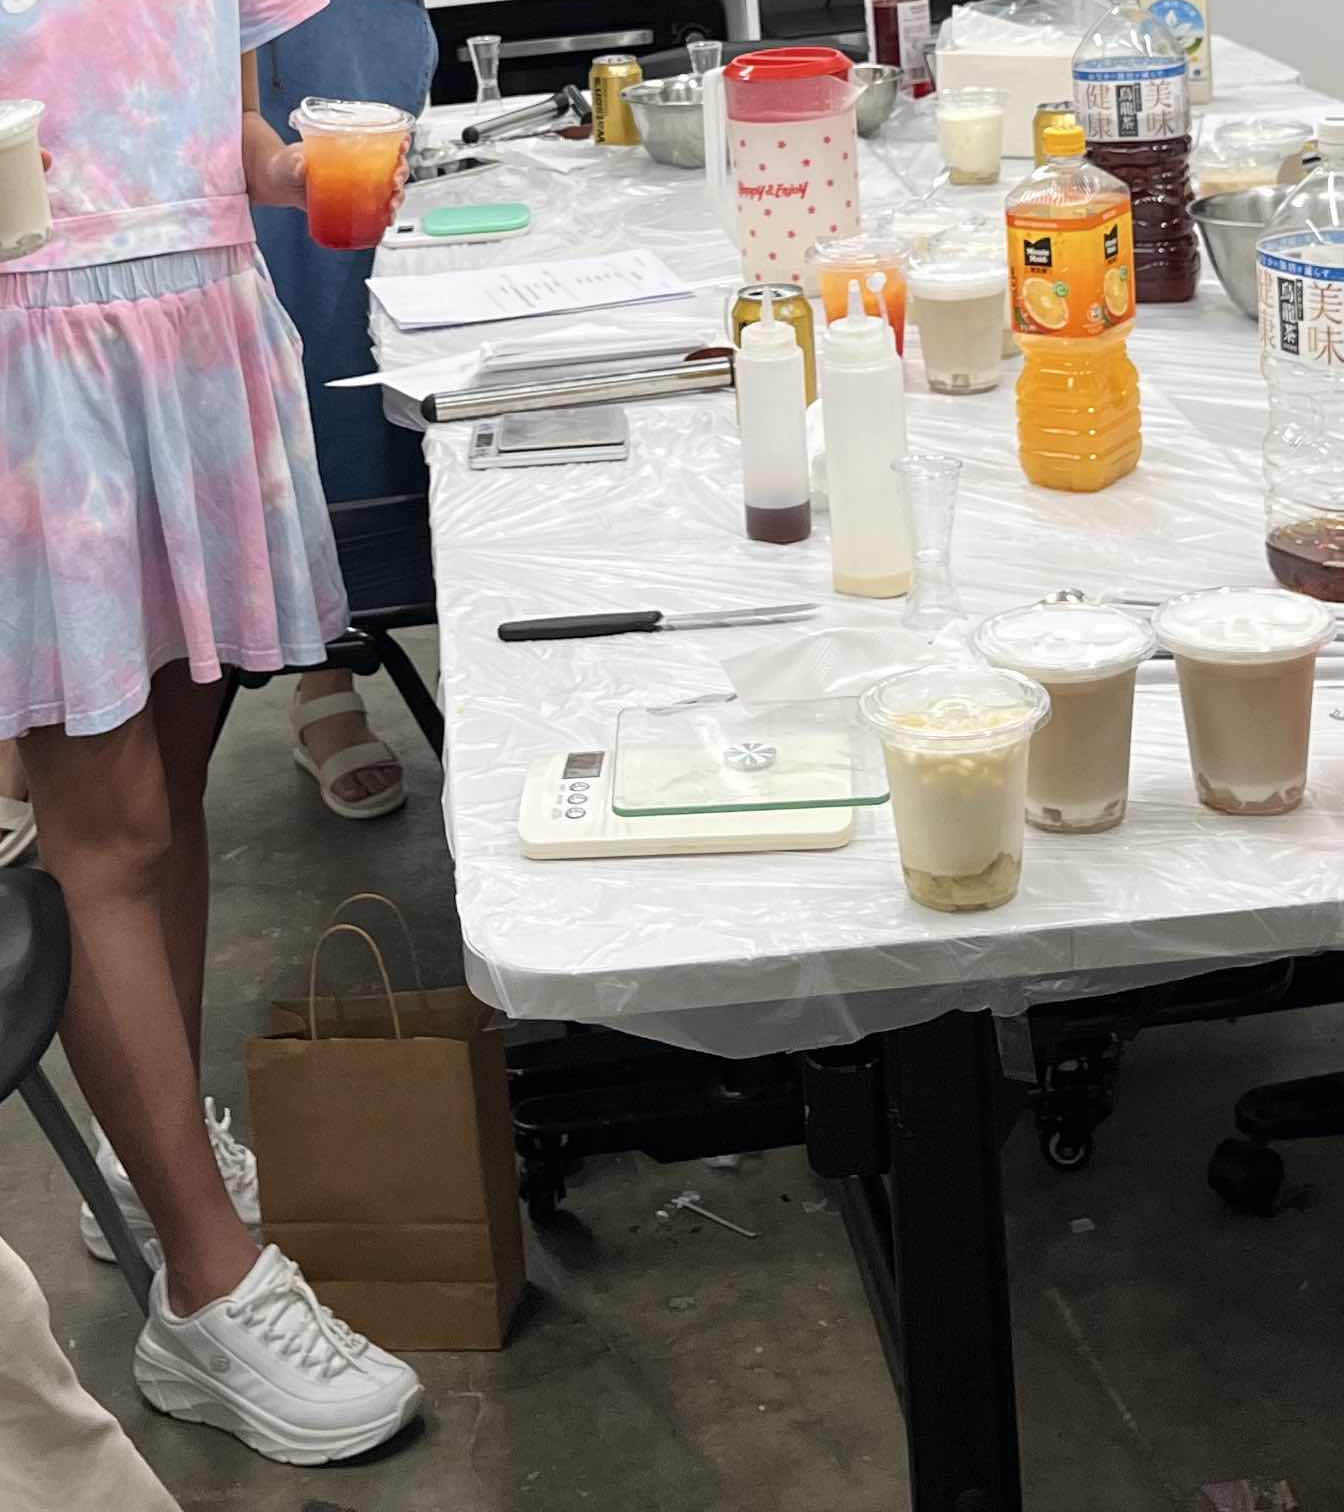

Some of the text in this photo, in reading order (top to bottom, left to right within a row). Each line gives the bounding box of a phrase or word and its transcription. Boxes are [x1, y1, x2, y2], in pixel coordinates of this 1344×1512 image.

[1087, 84, 1113, 138] 健康
[1146, 81, 1175, 137] 美味
[1309, 283, 1344, 366] 美味
